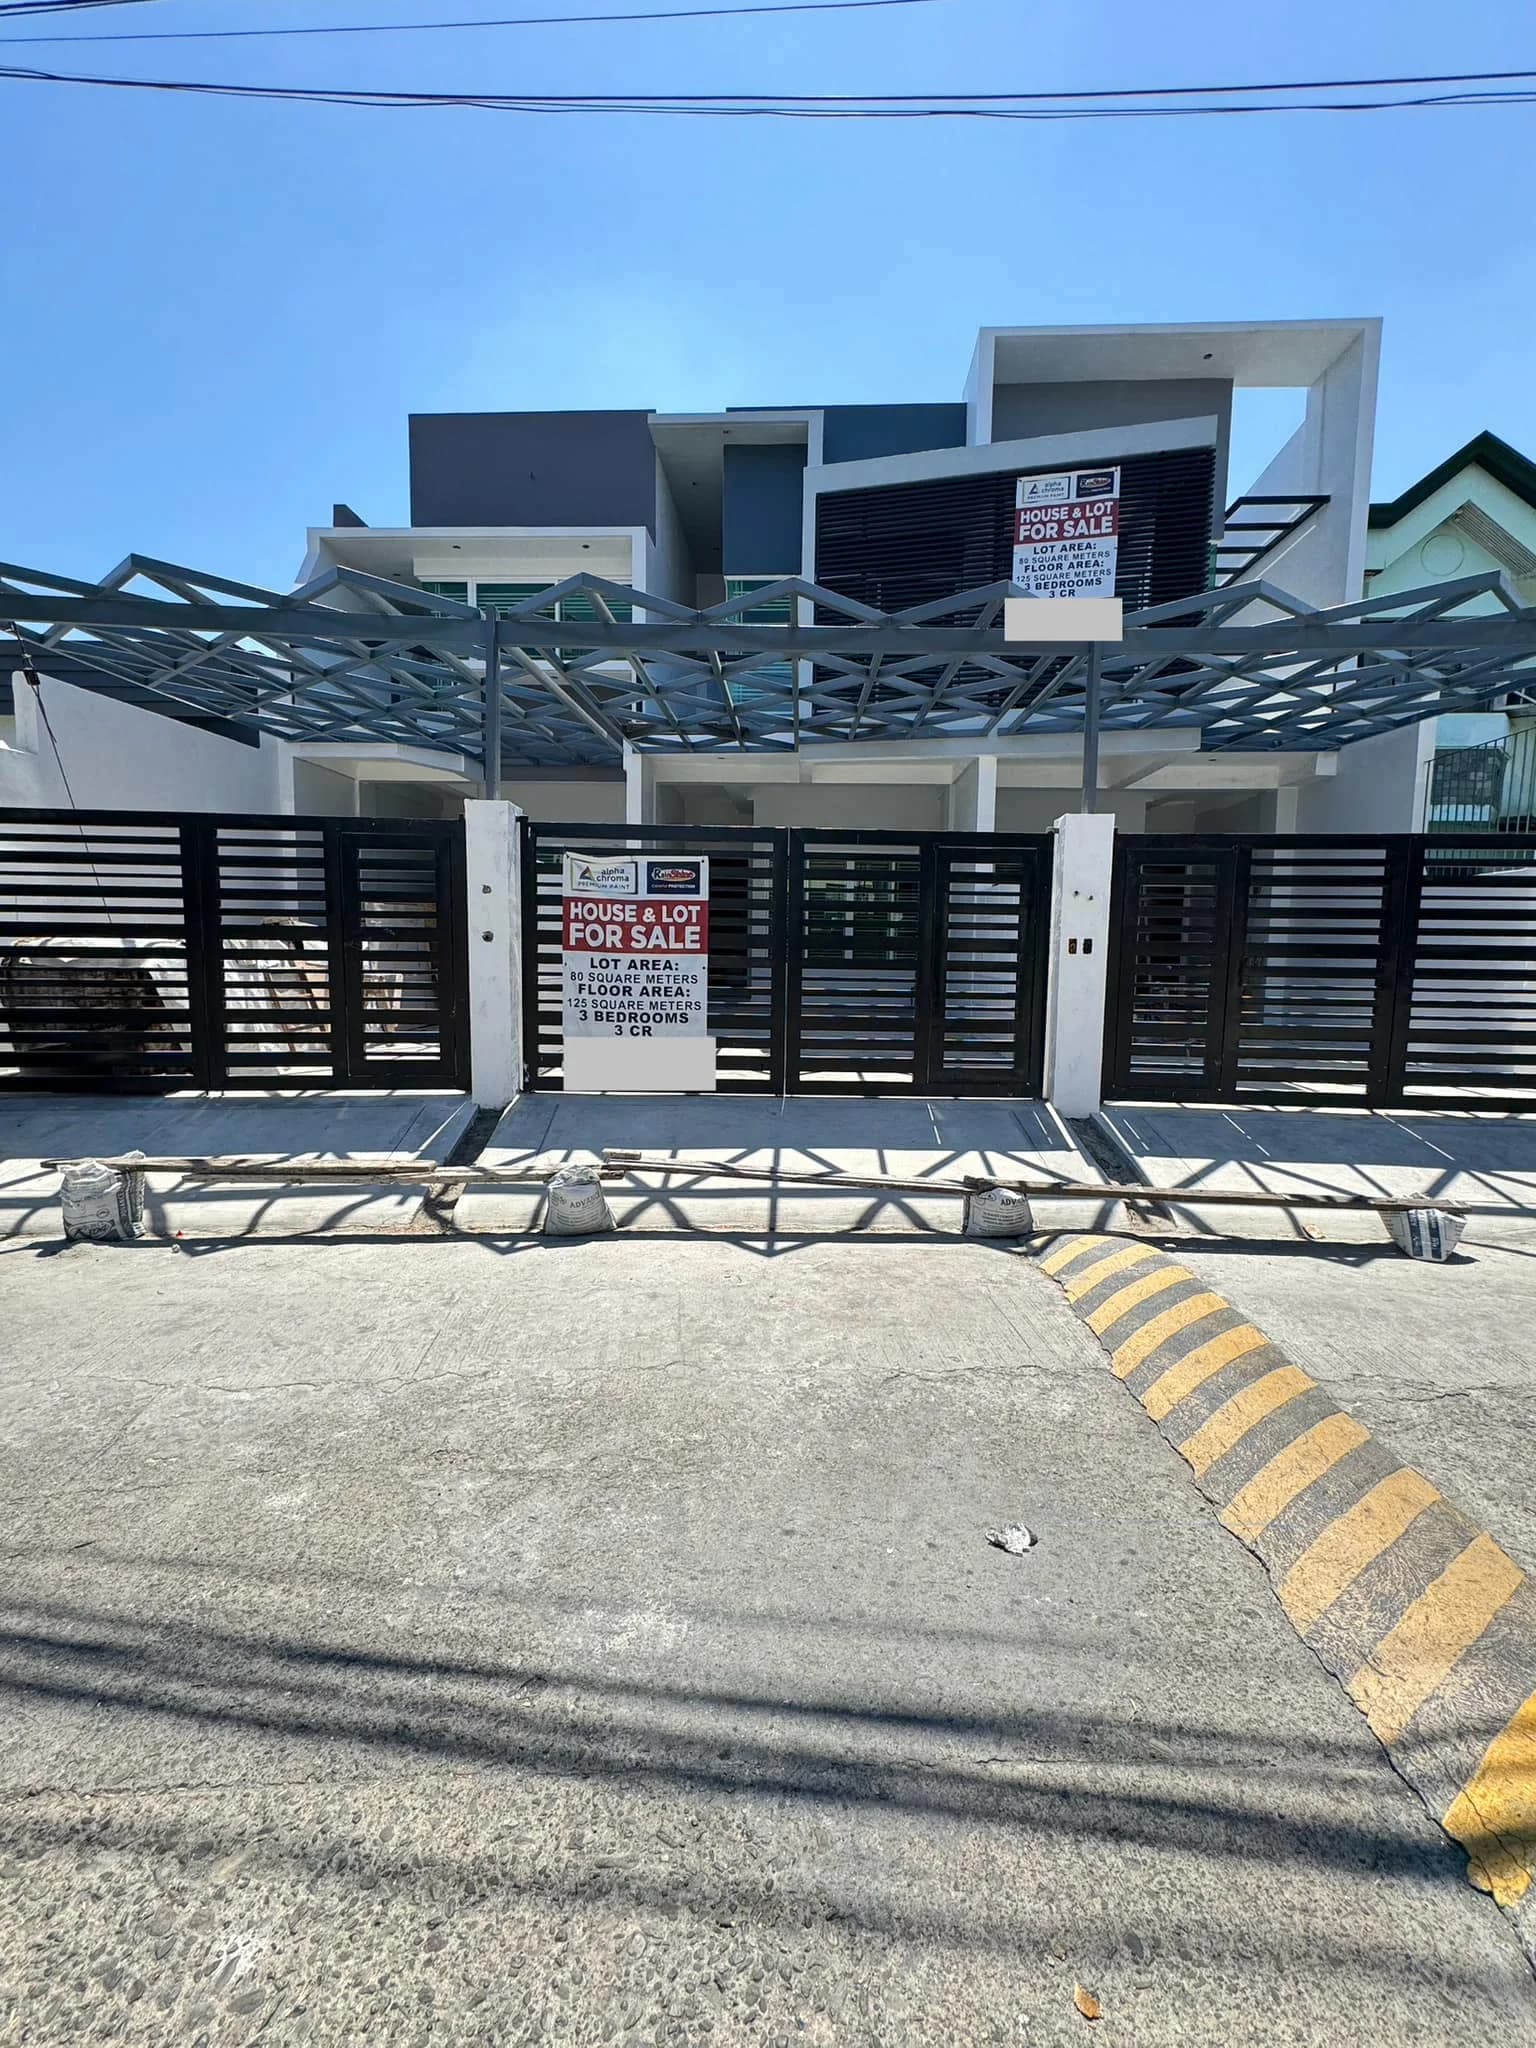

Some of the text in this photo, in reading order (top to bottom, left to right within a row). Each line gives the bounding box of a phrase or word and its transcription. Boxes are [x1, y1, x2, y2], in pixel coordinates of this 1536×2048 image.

[1020, 501, 1114, 523] HOUSE & LOT
[1019, 516, 1113, 541] FOR SALE
[1033, 542, 1097, 555] LOT AREA:
[1032, 554, 1069, 564] SQUARE
[1072, 550, 1110, 560] METERS
[1024, 560, 1104, 573] FLOOR AREA:
[1016, 568, 1112, 583] 125 SQUARE METERS
[1025, 577, 1102, 591] 3 BEDROOMS
[1049, 589, 1076, 598] 3 CR
[596, 874, 630, 883] chroma
[601, 867, 625, 876] alpha
[577, 881, 608, 889] PREMIUM
[569, 901, 701, 923] HOUSE & LOT
[569, 922, 701, 949] FOR SALE
[590, 957, 679, 971] LOT AREA:
[570, 971, 698, 985] 80 SQUARE METERS
[578, 983, 691, 997] FLOOR AREA:
[567, 998, 702, 1011] 125 SQUARE METERS
[579, 1010, 689, 1023] 3 BEDROOMS
[614, 1025, 653, 1037] 3 CR
